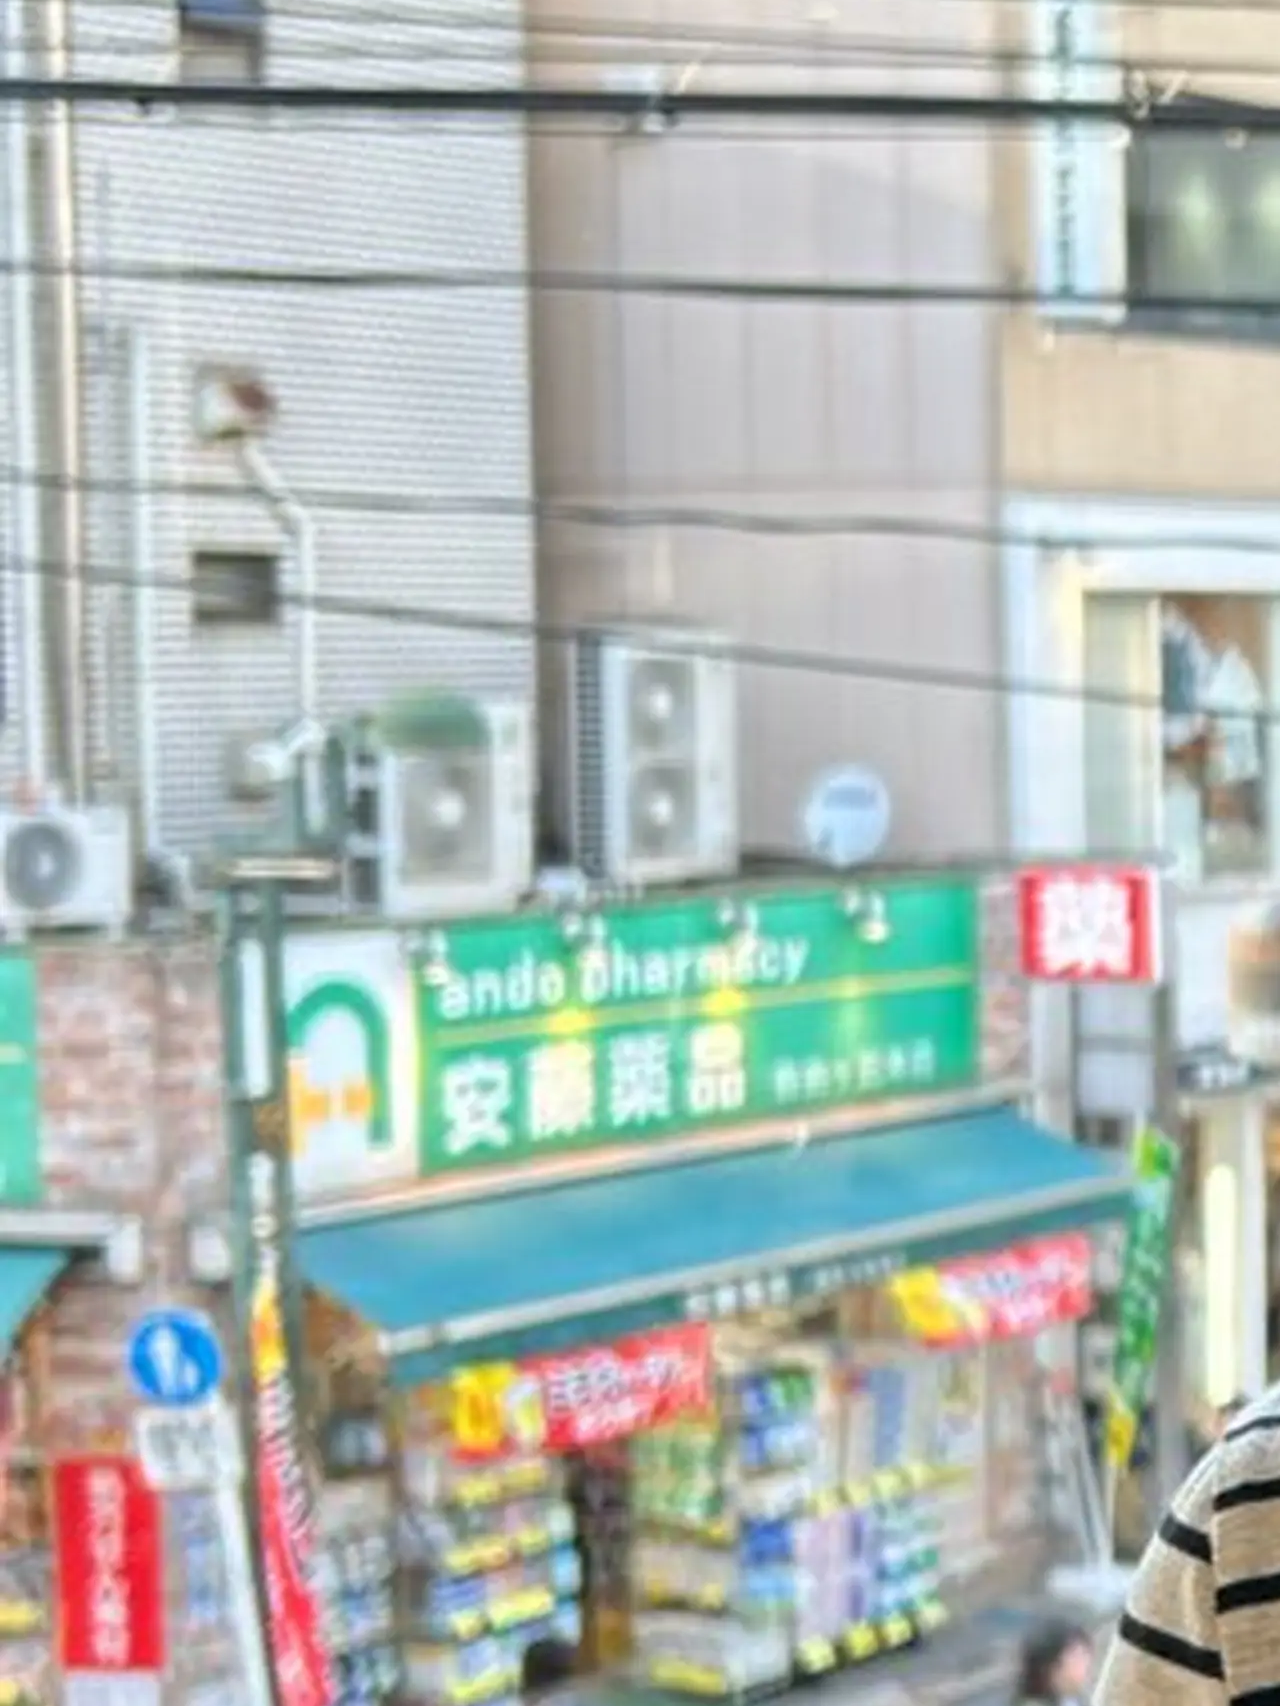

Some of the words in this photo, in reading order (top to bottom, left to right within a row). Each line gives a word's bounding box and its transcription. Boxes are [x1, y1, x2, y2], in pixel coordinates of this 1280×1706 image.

[436, 948, 566, 1020] ando
[440, 1021, 747, 1156] 安藤薬品
